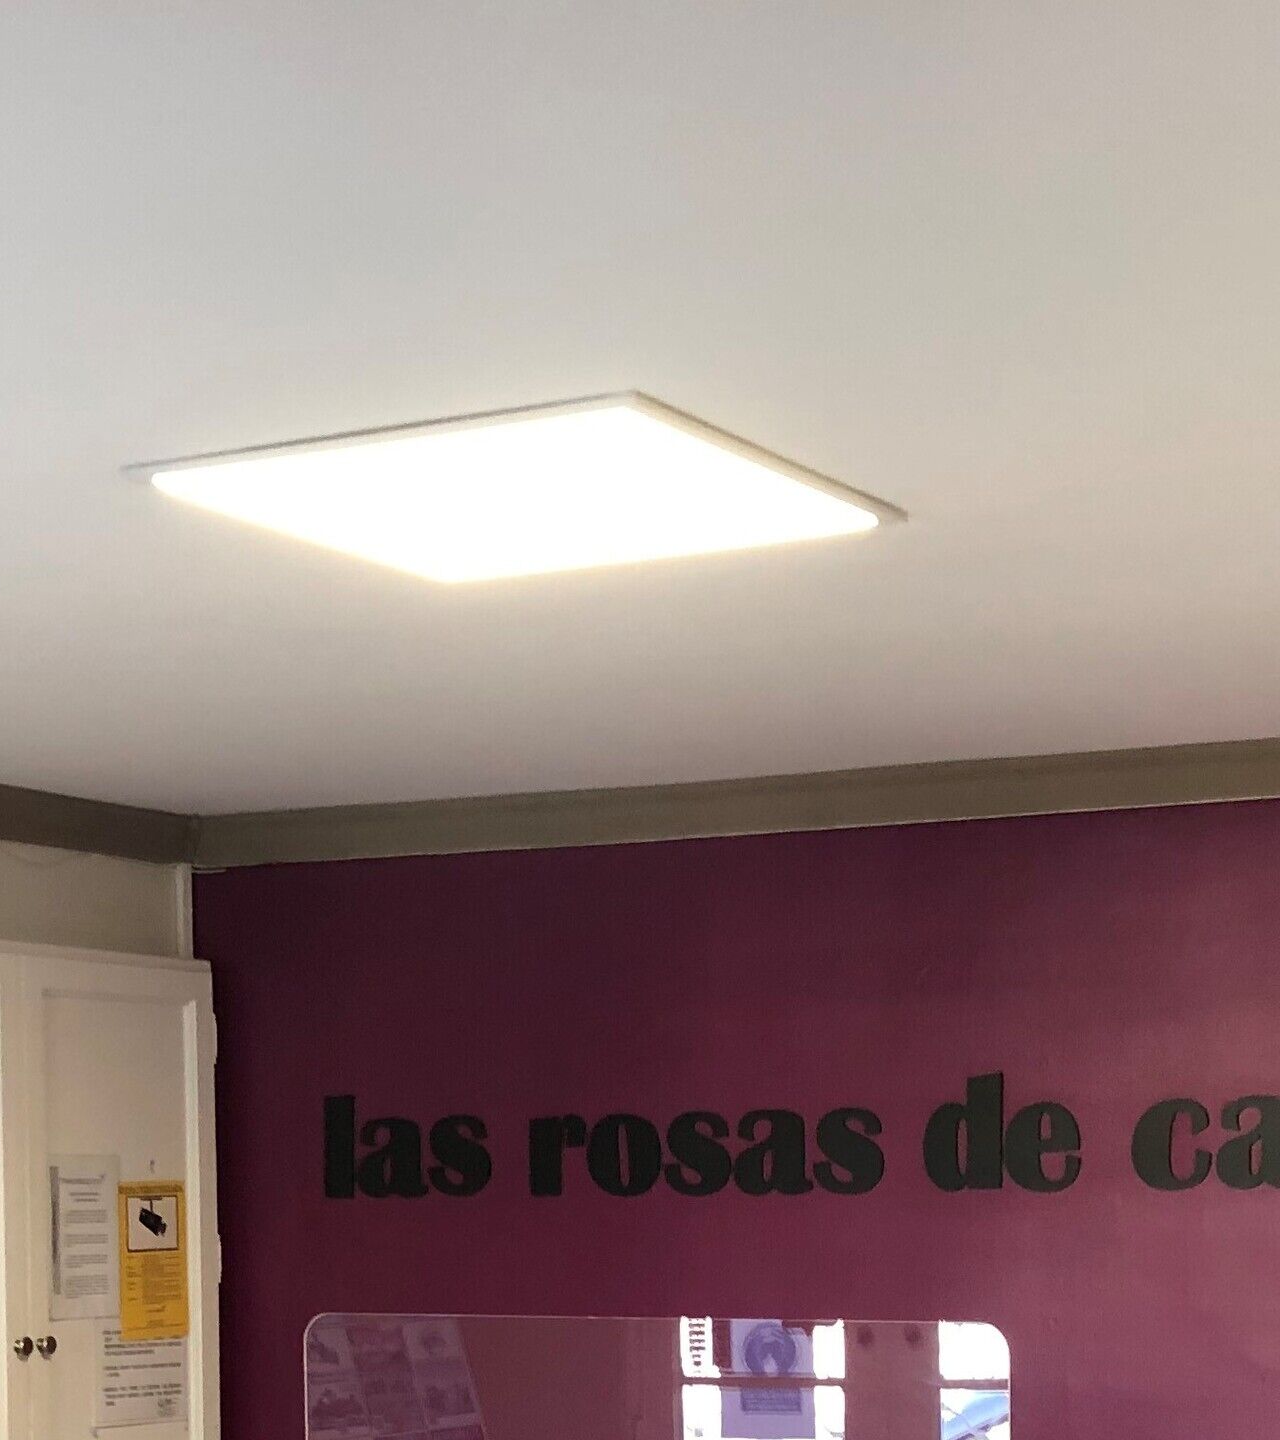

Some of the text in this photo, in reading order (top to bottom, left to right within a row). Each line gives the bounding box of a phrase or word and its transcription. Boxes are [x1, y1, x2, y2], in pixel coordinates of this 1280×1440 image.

[323, 1094, 493, 1198] las
[528, 1107, 885, 1197] rosas
[922, 1072, 1082, 1193] de
